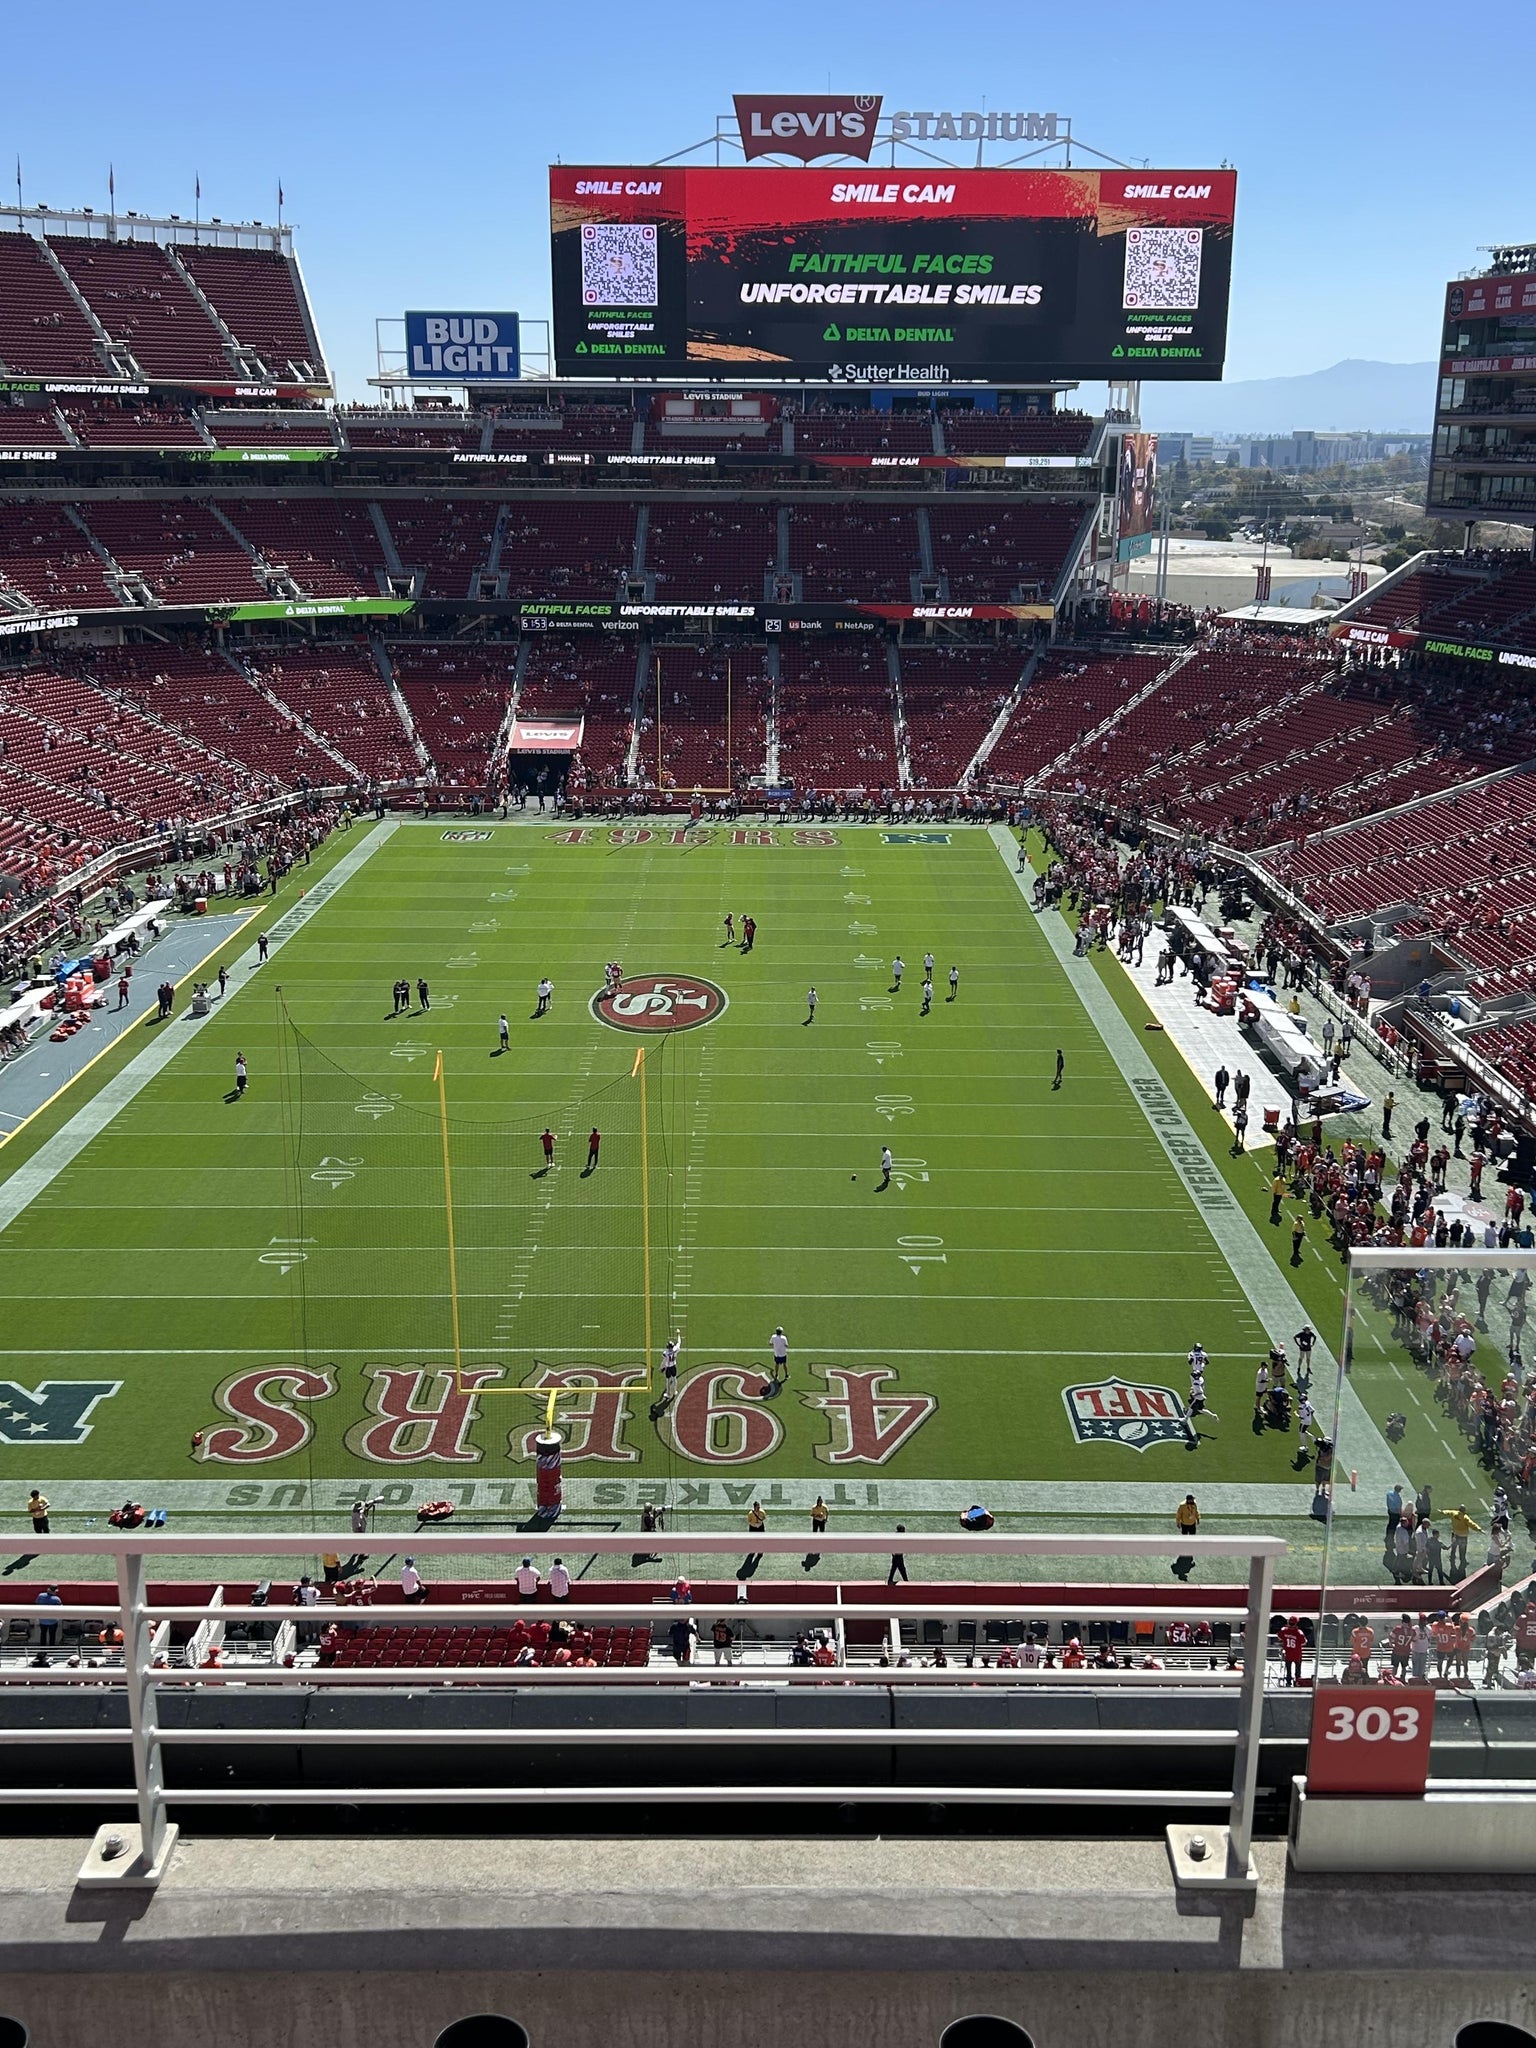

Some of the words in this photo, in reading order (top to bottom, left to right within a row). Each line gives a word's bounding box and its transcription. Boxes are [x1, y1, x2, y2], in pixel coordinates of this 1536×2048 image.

[891, 111, 1058, 141] STADIUM
[575, 180, 623, 195] SMILE
[625, 181, 662, 196] CAM
[830, 184, 900, 203] SMILE
[902, 184, 956, 204] CAM
[1123, 184, 1172, 198] SMILE
[1173, 185, 1211, 199] CAM
[788, 253, 907, 273] FAITHFUL
[911, 254, 994, 274] FACES
[740, 283, 952, 304] UNFORGETTABLE
[953, 285, 1043, 305] SMILES
[588, 311, 626, 319] FAITHFUL
[627, 311, 653, 319] FACES
[1127, 314, 1165, 322] FAITHFUL
[425, 318, 499, 345] BUD
[587, 323, 655, 331] UNFORGETTABLE
[607, 330, 635, 338] SMILES
[846, 327, 891, 341] DELTA
[894, 328, 954, 342] DENTAL
[1125, 326, 1193, 334] UNFORGETTABLE
[1144, 334, 1173, 342] SMILES
[591, 344, 622, 354] DELTA
[624, 345, 666, 354] DENTAL
[1127, 347, 1159, 357] DELTA
[1160, 348, 1202, 357] DENTAL
[412, 345, 513, 372] LIGHT
[845, 364, 896, 380] Sutter
[897, 364, 950, 379] Health
[11, 383, 40, 392] FACES
[45, 384, 119, 394] UNFORGETTABLE
[119, 385, 149, 395] SMILES
[235, 387, 259, 396] SMILE
[259, 387, 277, 396] CAM
[22, 451, 57, 460] SMILES
[267, 453, 290, 461] DENTAL
[453, 454, 497, 463] FAITHFUL
[498, 454, 528, 463] FACES
[607, 455, 683, 464] UNFORGETTABLE
[684, 456, 716, 465] SMILES
[871, 457, 899, 466] SMILE
[899, 457, 919, 466] CAM
[296, 606, 317, 615] DELTA
[317, 604, 345, 614] DENTAL
[520, 605, 574, 615] FAITHFUL
[575, 605, 612, 615] FACES
[620, 606, 715, 616] UNFORGETTABLE
[715, 606, 755, 616] SMILES
[912, 607, 946, 617] SMILE
[946, 608, 973, 617] CAM
[47, 615, 79, 630] SMILES
[601, 619, 639, 630] verizon
[767, 620, 780, 631] 25
[800, 620, 822, 629] bank
[844, 621, 875, 631] NetApp
[1349, 628, 1371, 642] SMILE
[1371, 631, 1390, 644] CAM
[1425, 640, 1464, 656] FAITHFUL
[1464, 645, 1494, 661] FACES
[544, 826, 842, 848] 49ERS
[859, 996, 894, 1011] 50
[866, 1041, 904, 1058] 40
[874, 1094, 916, 1115] 30
[1132, 1077, 1183, 1126] CANCER
[311, 1156, 365, 1181] 20
[889, 1158, 930, 1183] 20
[1161, 1131, 1235, 1210] INTERCEPT
[258, 1236, 319, 1264] 10
[897, 1235, 948, 1264] 10
[1076, 1386, 1174, 1418] NFL
[189, 1360, 940, 1466] 49ERS
[225, 1484, 308, 1507] US
[337, 1483, 414, 1506] OF
[593, 1483, 792, 1505] TAKES
[833, 1483, 879, 1505] IT
[462, 1589, 484, 1600] pwc
[1172, 1630, 1187, 1642] 54
[1285, 1638, 1297, 1649] 16
[1360, 1636, 1368, 1647] 2
[1397, 1634, 1412, 1646] 97
[1437, 1633, 1449, 1644] 10
[1024, 1653, 1035, 1664] 10
[1325, 1706, 1420, 1741] 303
